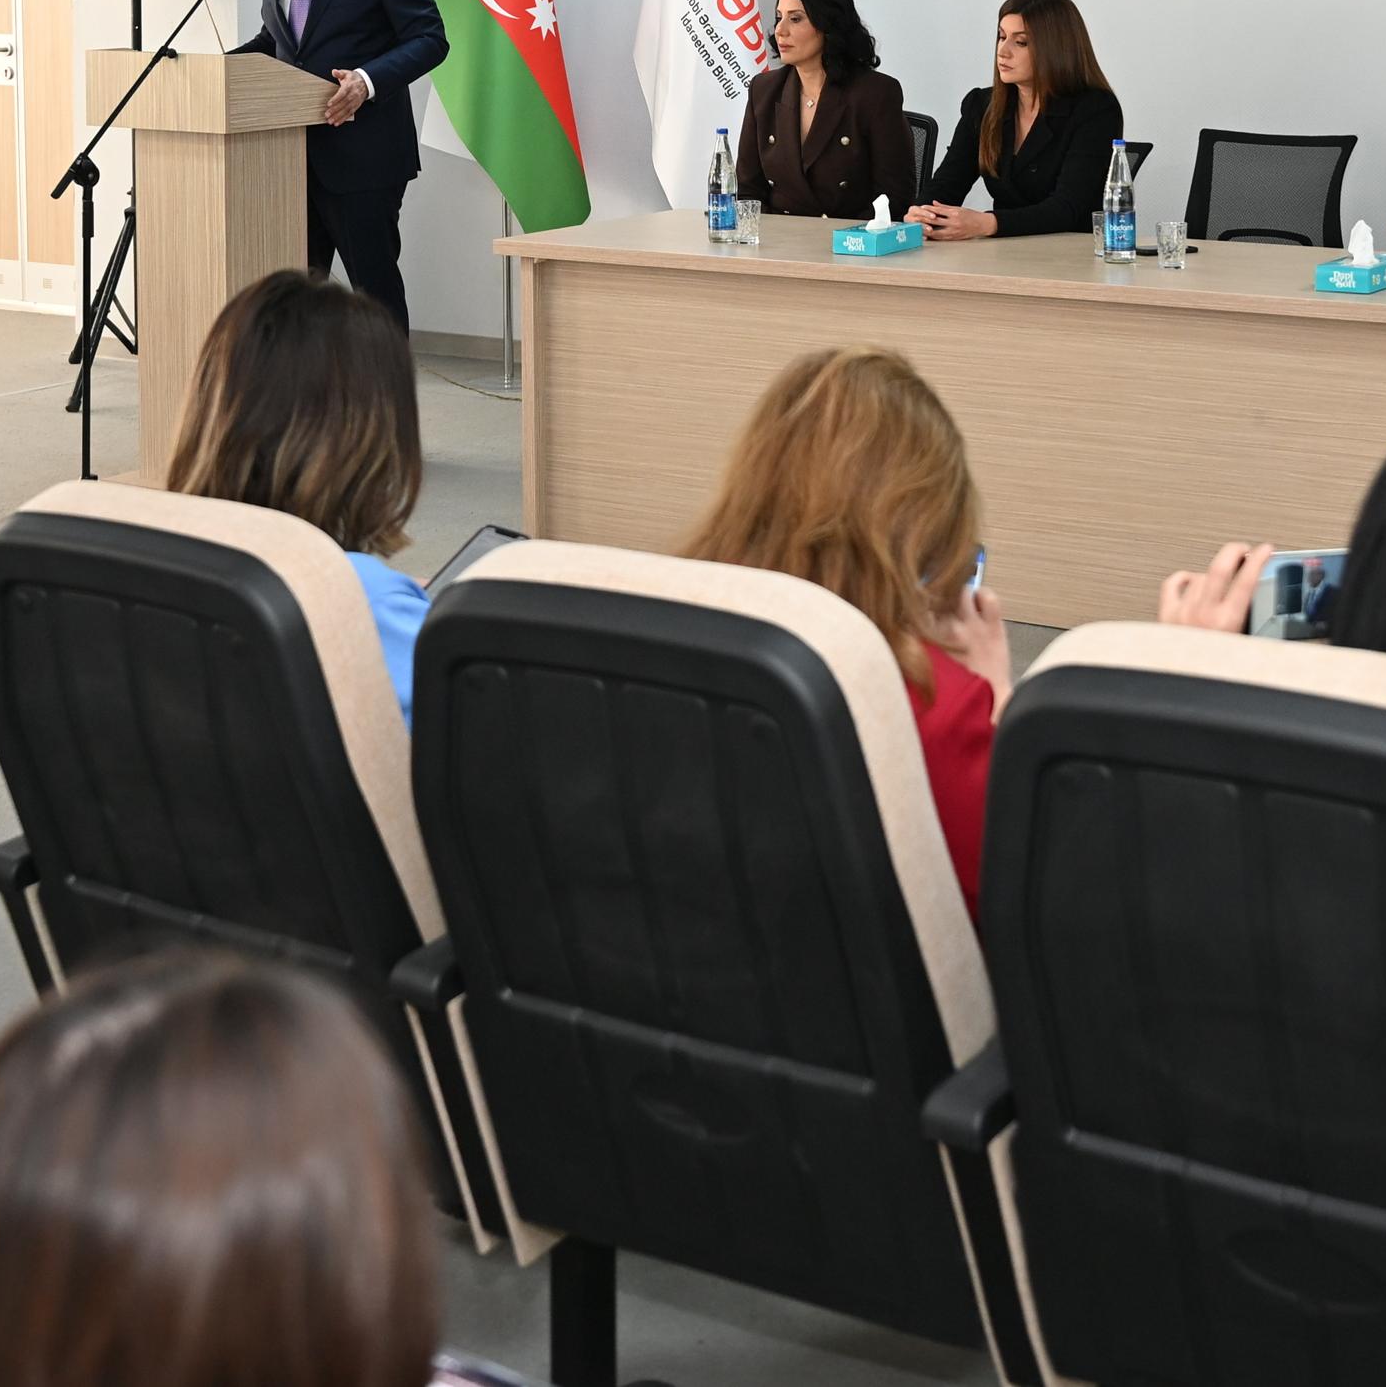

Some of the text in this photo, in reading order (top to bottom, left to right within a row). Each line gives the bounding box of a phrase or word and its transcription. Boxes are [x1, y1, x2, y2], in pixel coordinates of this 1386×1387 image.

[680, 10, 741, 100] İdarəetmə Birliyi
[698, 14, 723, 45] Ərazi
